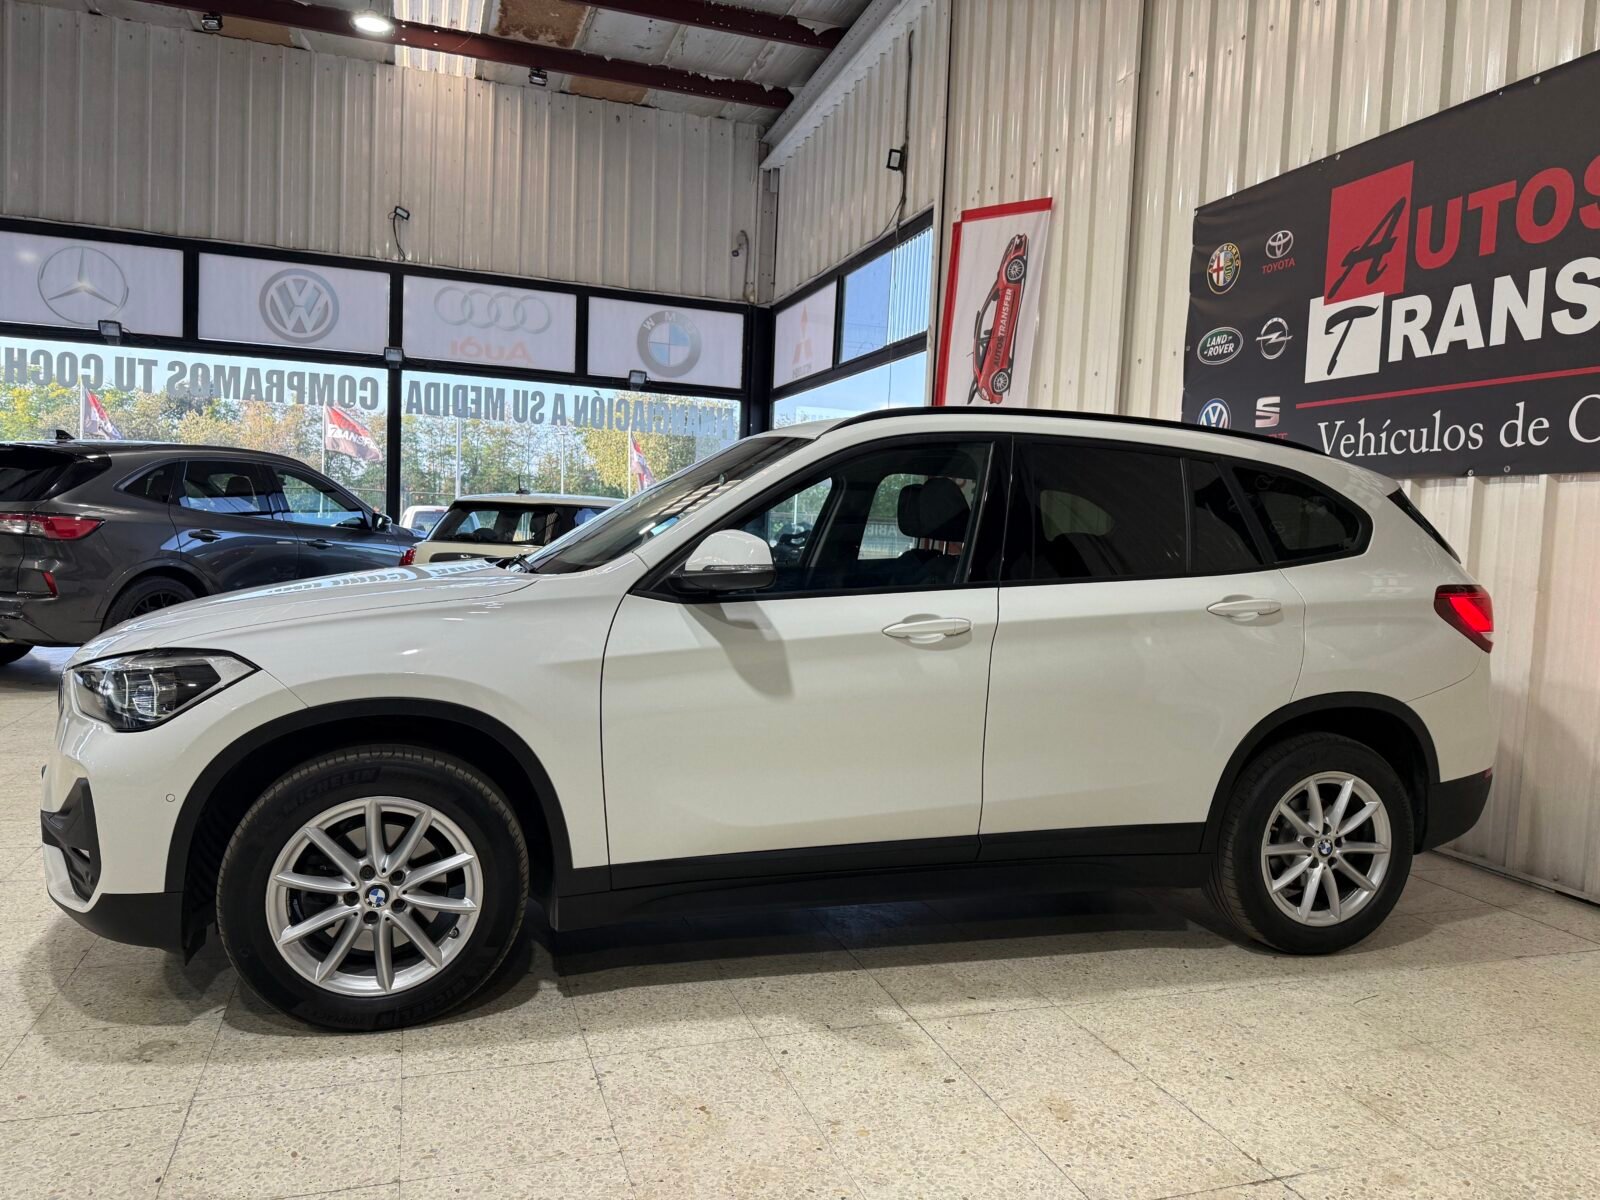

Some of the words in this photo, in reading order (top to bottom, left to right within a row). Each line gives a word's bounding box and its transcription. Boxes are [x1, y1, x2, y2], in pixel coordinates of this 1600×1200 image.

[1262, 257, 1296, 274] TOYOTA
[1324, 257, 1600, 376] TRANS
[1206, 334, 1229, 348] LAND
[1317, 410, 1484, 458] Vehículos
[1500, 401, 1550, 447] de
